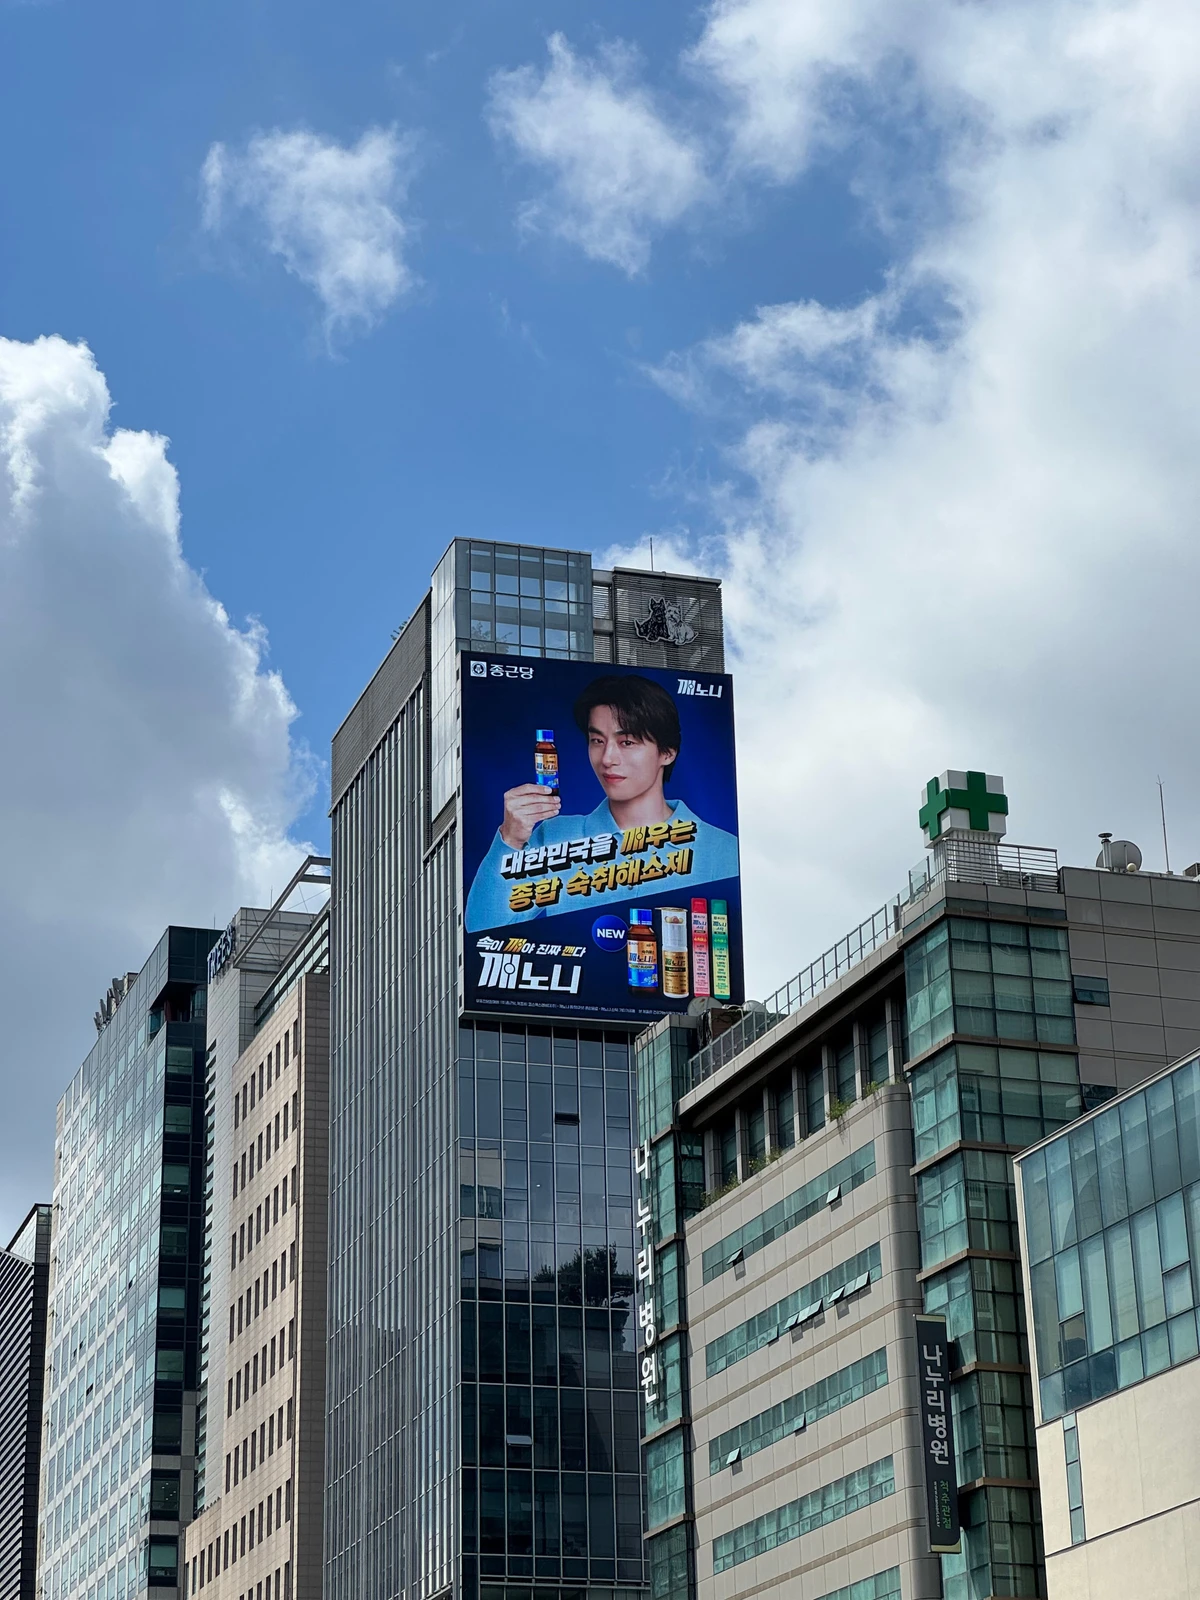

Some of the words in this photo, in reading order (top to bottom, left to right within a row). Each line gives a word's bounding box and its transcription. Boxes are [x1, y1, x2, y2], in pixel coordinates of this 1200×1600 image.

[490, 663, 534, 679] 종근당
[677, 679, 723, 698] 깨노니
[500, 832, 615, 876] 대한민국을
[620, 819, 696, 853] 깨우는
[509, 877, 562, 909] 종합
[566, 848, 690, 894] 숙취해소제
[476, 936, 504, 951] 속이
[503, 938, 535, 953] 깨야
[536, 944, 561, 955] 진짜
[561, 946, 586, 957] 깬다
[596, 928, 626, 939] NEW
[478, 952, 581, 994] 깨노니
[634, 1139, 658, 1404] 나누리병원
[922, 1344, 949, 1466] 나누리병원
